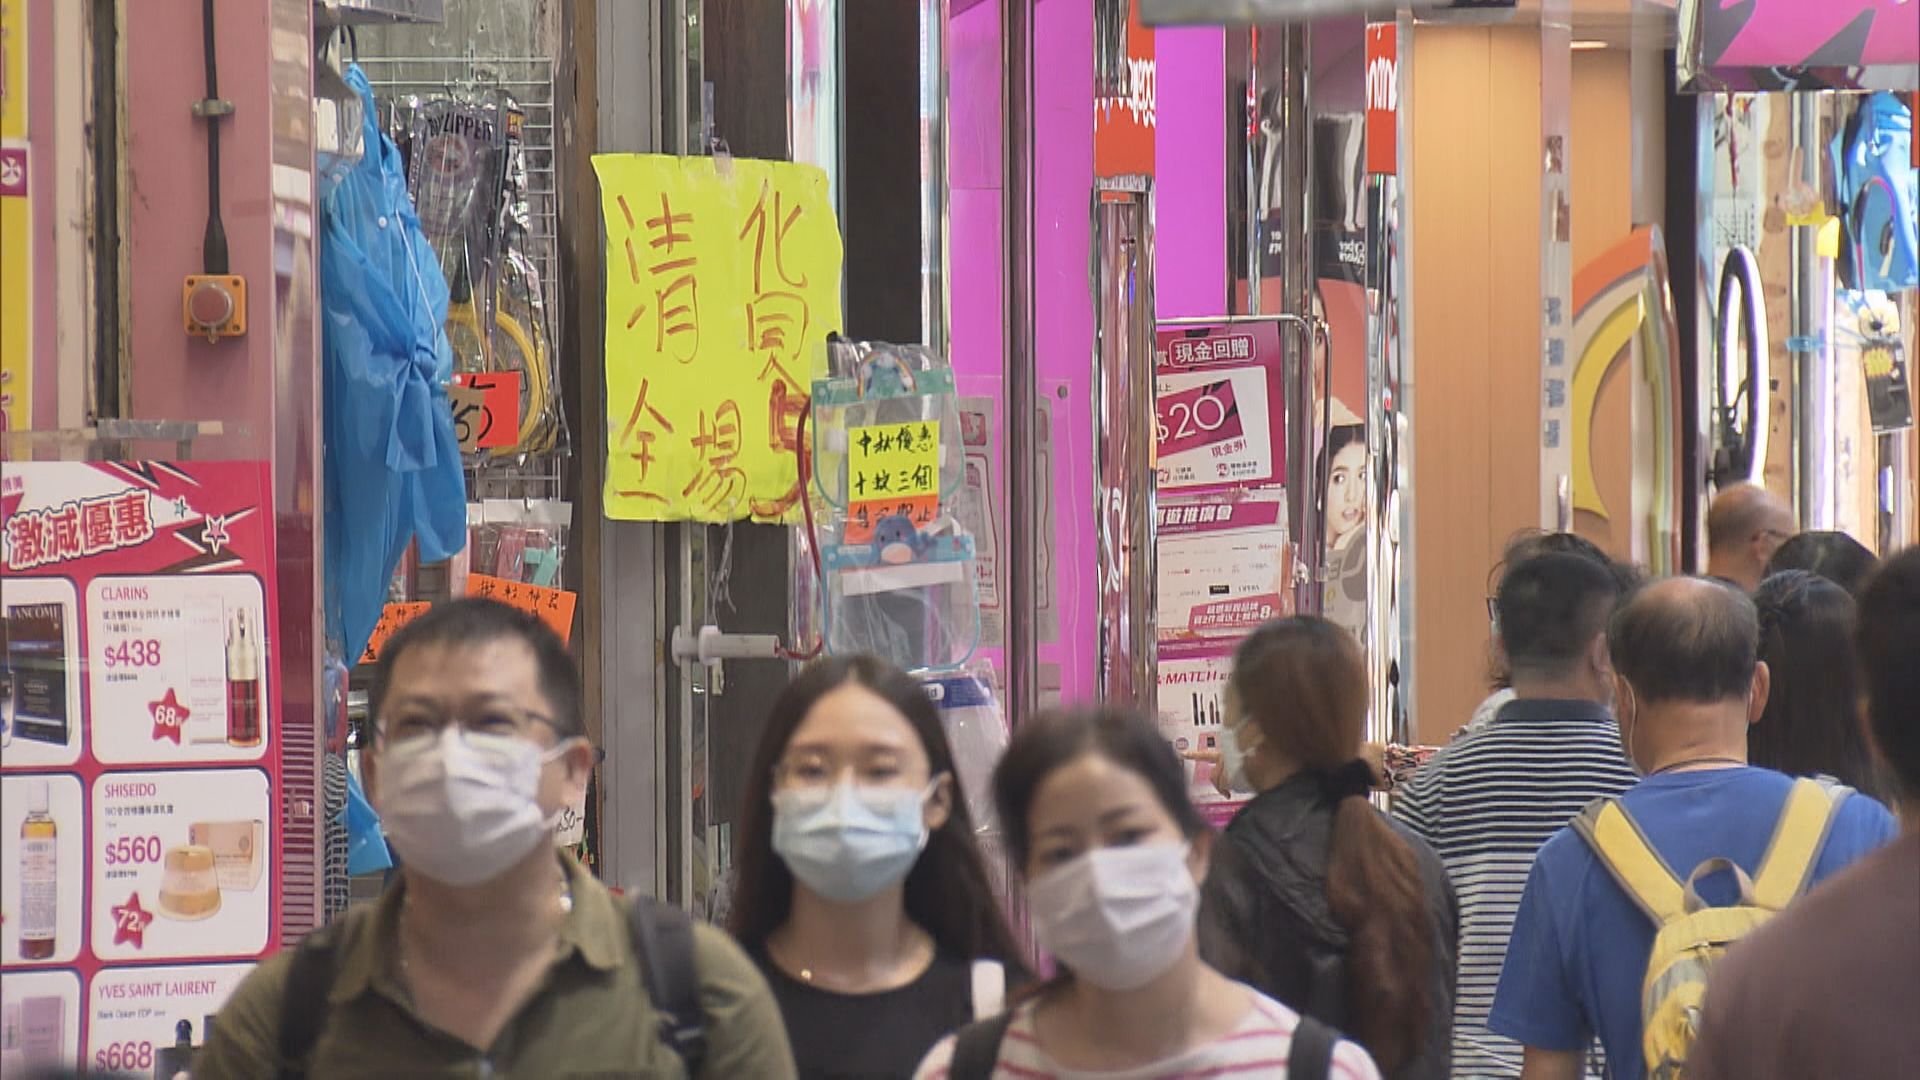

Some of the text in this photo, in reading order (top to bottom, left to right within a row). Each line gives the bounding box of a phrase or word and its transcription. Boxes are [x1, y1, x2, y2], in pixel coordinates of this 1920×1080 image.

[1175, 337, 1249, 363] 現金回贈
[1157, 394, 1225, 444] $20
[857, 423, 934, 457] 中秋優惠
[9, 491, 152, 567] 激減優惠
[101, 586, 149, 601] CLARINS
[104, 639, 161, 668] $438
[104, 782, 157, 798] SHISEIDO
[105, 835, 161, 865] $560
[98, 981, 216, 999] YVES SAINT LAURENT
[95, 1040, 152, 1073] $668
